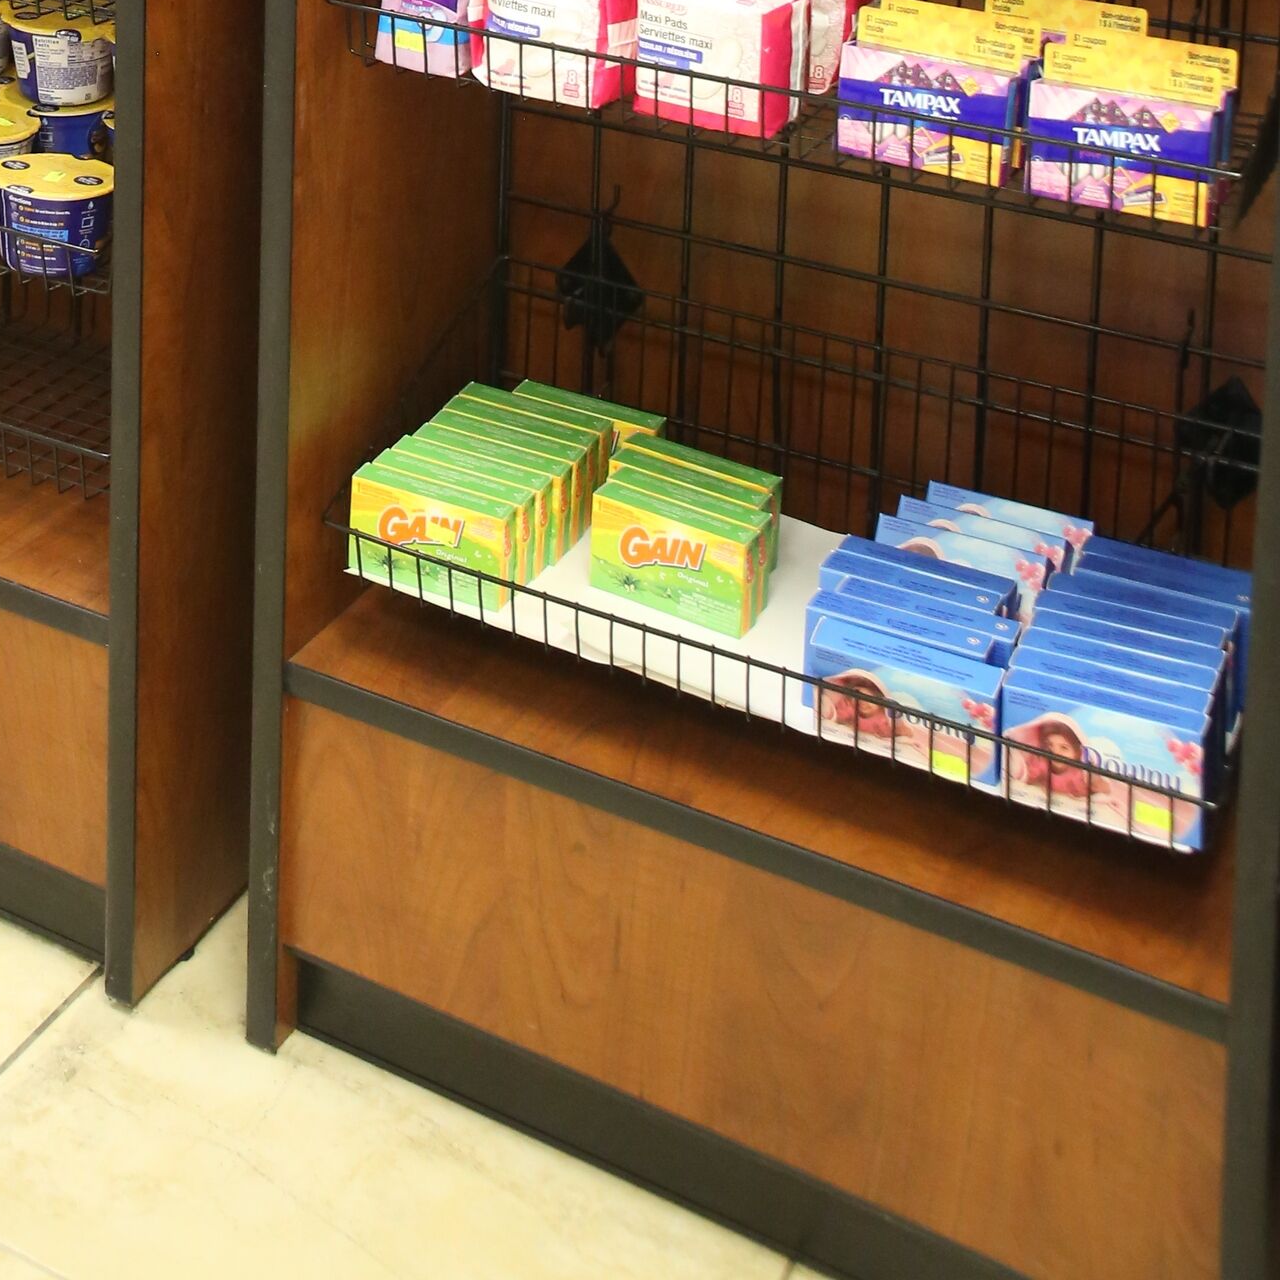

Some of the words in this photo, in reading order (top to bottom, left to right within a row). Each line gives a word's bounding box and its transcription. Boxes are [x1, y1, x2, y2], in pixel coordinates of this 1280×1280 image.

[531, 5, 556, 19] maxi
[896, 6, 919, 16] coupon
[992, 4, 1011, 14] Inside
[640, 10, 662, 24] Maxi
[665, 16, 688, 30] Pads
[874, 17, 898, 28] coupon
[640, 24, 686, 44] Serviettes
[689, 36, 713, 51] maxi
[1082, 36, 1107, 46] coupon
[1061, 53, 1086, 64] coupon
[567, 69, 578, 85] 8
[814, 65, 825, 79] 8
[734, 87, 744, 103] 8
[879, 87, 961, 115] TAMPAX
[1073, 127, 1162, 152] TAMPAX
[436, 548, 468, 564] Original
[619, 525, 708, 572] GAIN
[677, 572, 709, 588] Original
[1083, 747, 1182, 791] Downy
